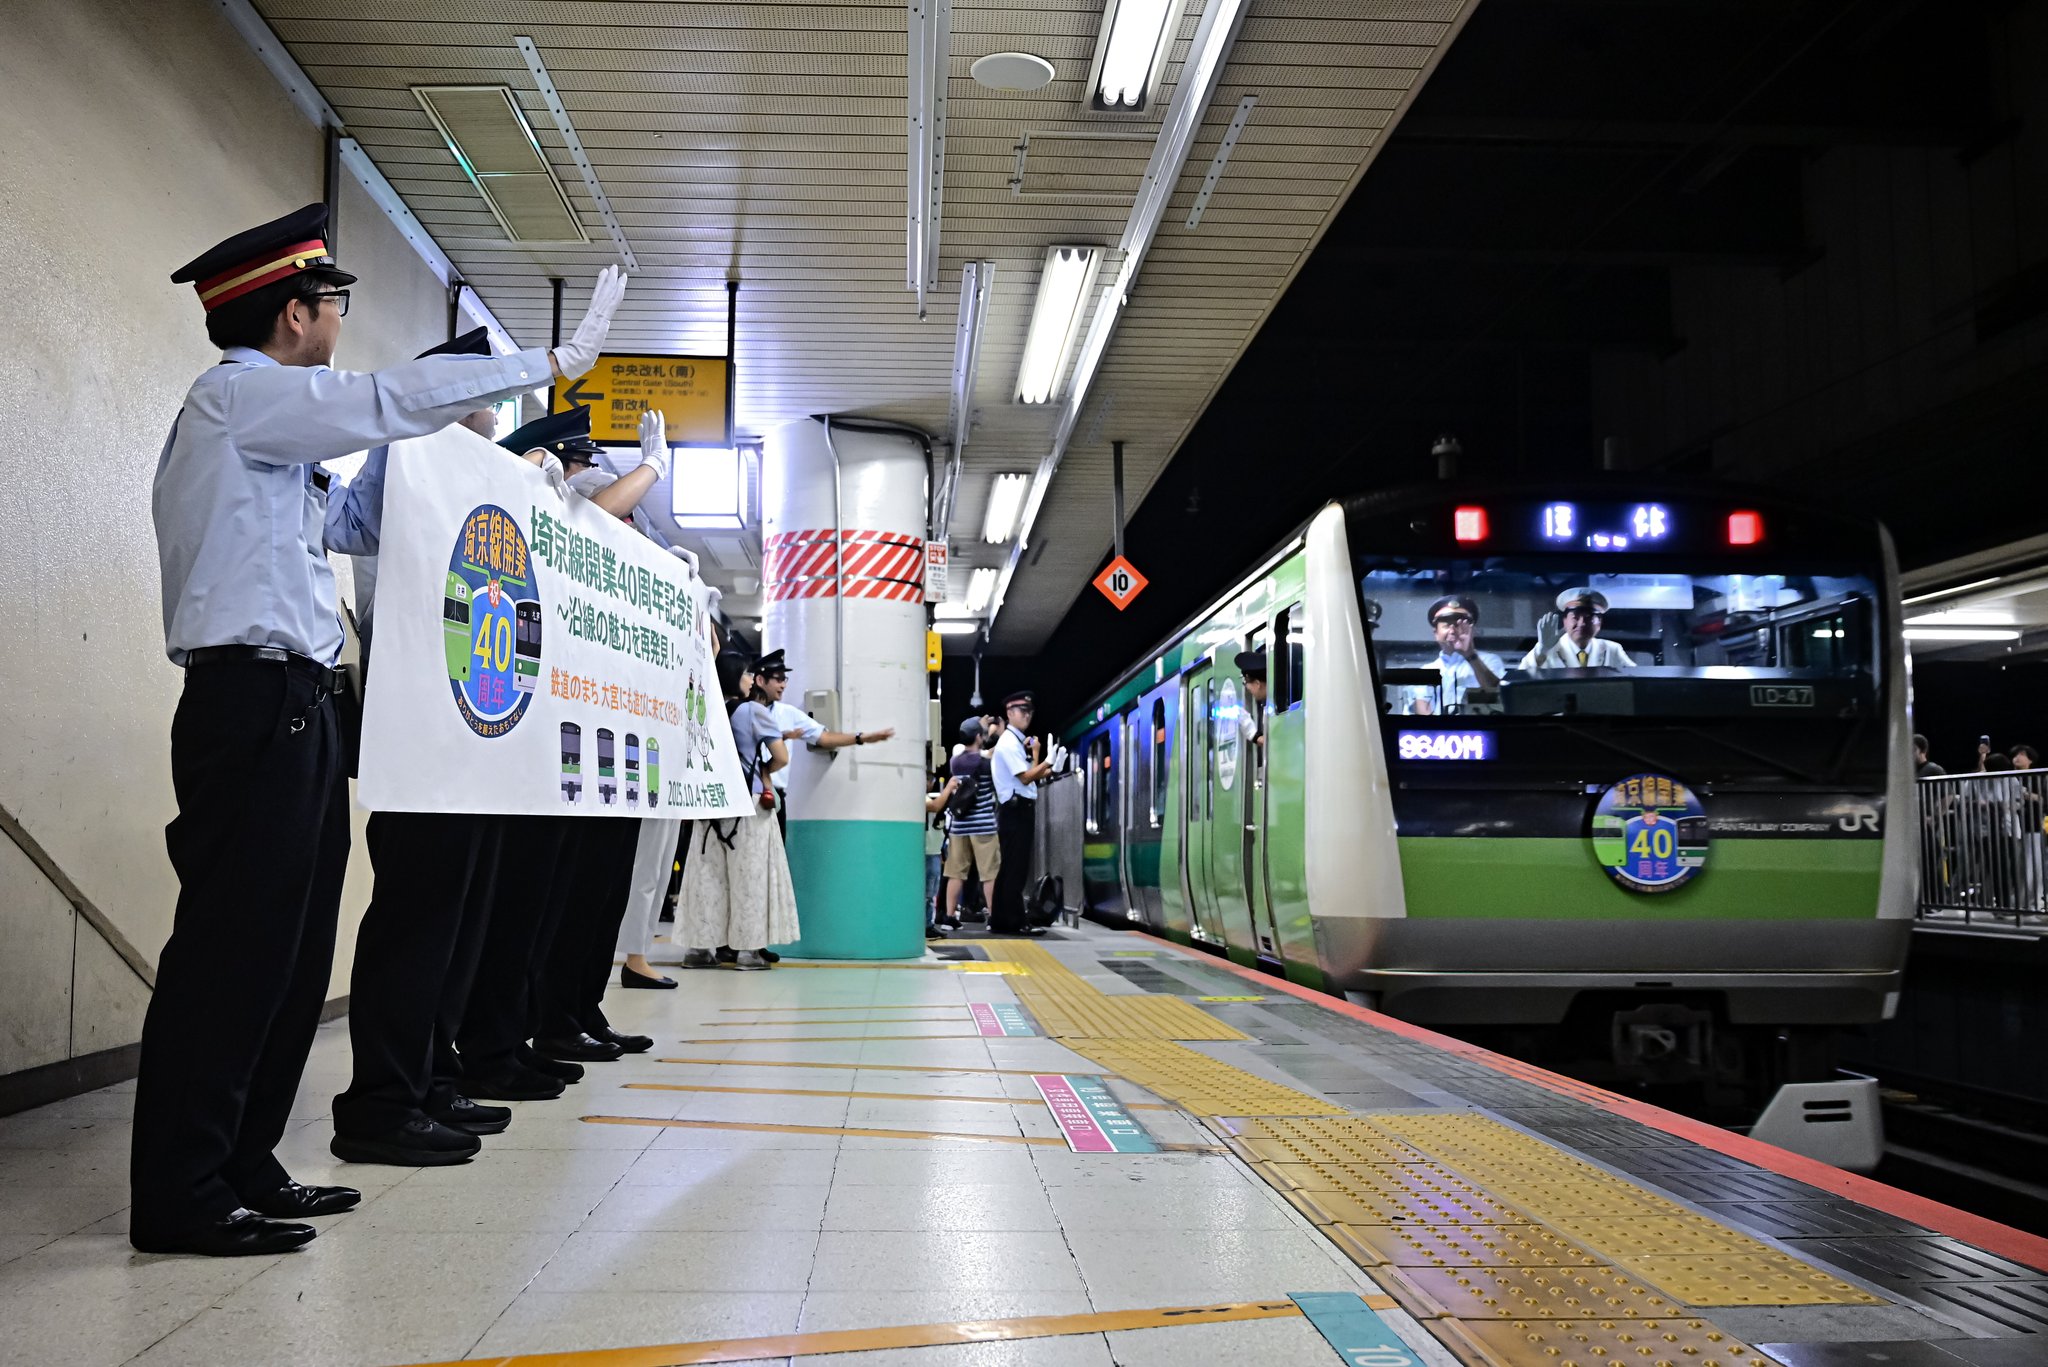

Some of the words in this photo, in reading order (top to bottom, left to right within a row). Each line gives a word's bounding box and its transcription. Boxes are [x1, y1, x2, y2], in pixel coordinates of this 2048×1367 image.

[612, 364, 696, 378] 中央改札（南）
[643, 379, 662, 387] Gate
[463, 510, 527, 579] 埼京線開業
[530, 505, 693, 637] 埼京線開業40周年記念号
[1112, 574, 1129, 591] 10
[489, 582, 500, 606] 祝
[473, 613, 512, 672] 40
[477, 674, 505, 710] 周年
[551, 666, 600, 706] 鉄道のまち
[457, 695, 523, 736] ありがとうを超えたおもてなし
[1709, 823, 1738, 832] APAN
[1739, 823, 1778, 832] RAILWAY
[1780, 823, 1832, 832] COMPANY
[1839, 806, 1880, 832] JR
[1630, 829, 1673, 859] 40
